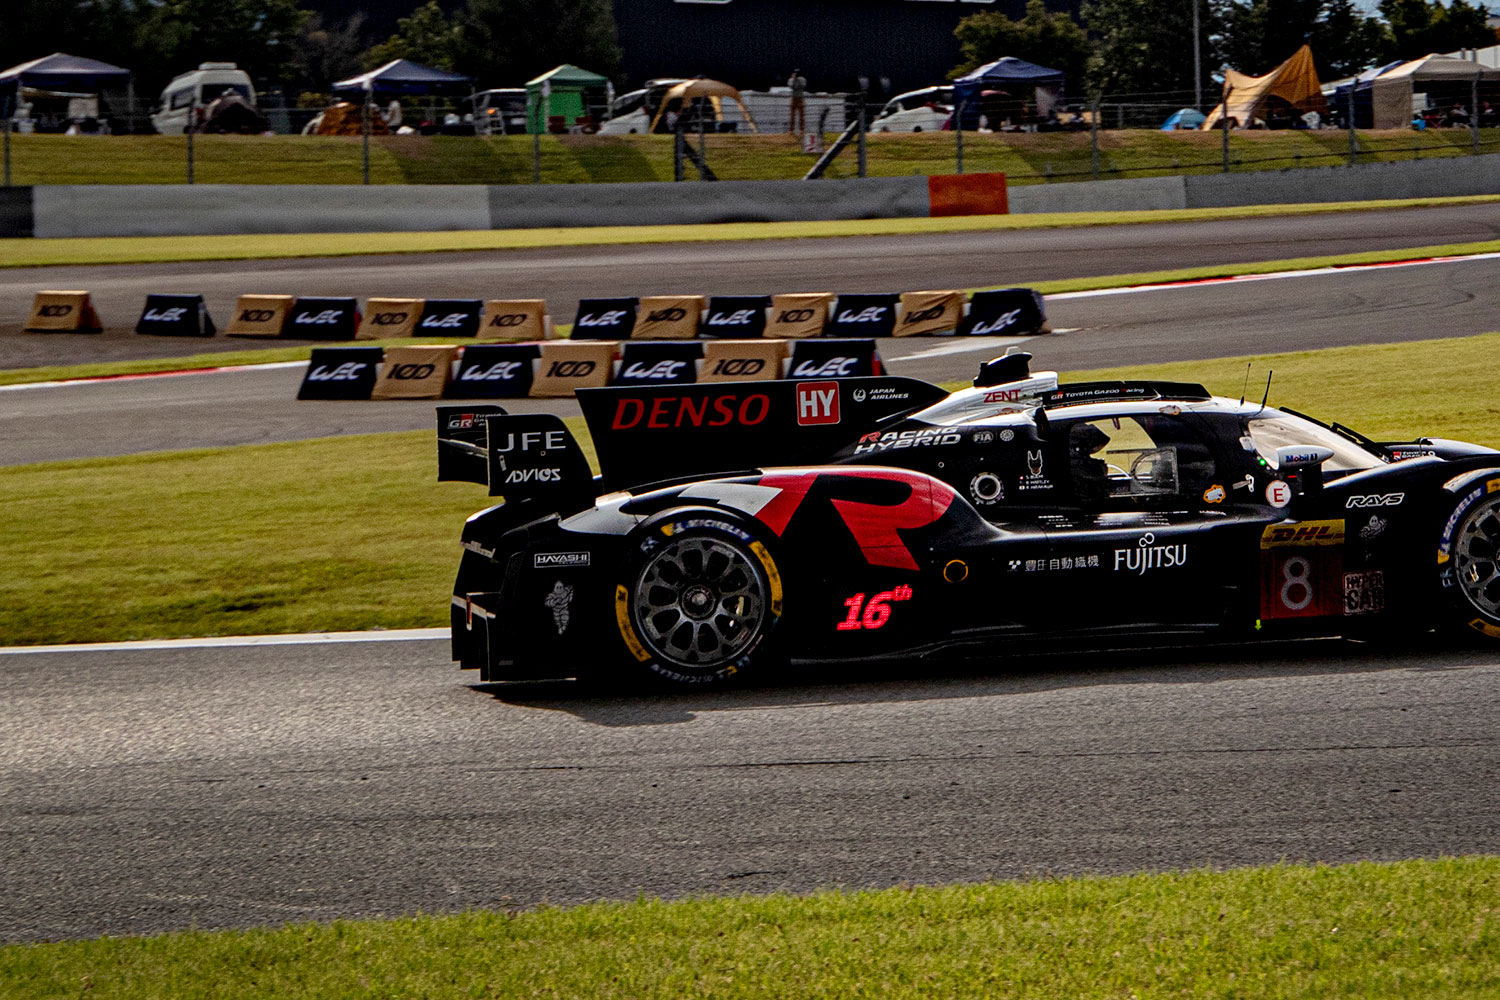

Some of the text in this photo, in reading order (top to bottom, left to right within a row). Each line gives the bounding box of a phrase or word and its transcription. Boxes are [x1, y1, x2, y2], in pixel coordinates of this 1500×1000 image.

[144, 307, 188, 322] WEC
[295, 310, 344, 325] WEC
[422, 313, 469, 328] WEC
[579, 310, 628, 327] WEC
[708, 309, 756, 325] WEC
[837, 306, 888, 323] WEC
[971, 308, 1022, 335] WEC
[308, 362, 367, 381] WEC
[460, 361, 523, 382] WEC
[623, 359, 687, 380] WEC
[793, 357, 859, 377] WEC
[870, 392, 909, 400] AIRLINES
[983, 389, 1022, 403] ZENT
[1065, 391, 1093, 399] TOYOTA
[611, 394, 770, 430] DENSO
[799, 389, 836, 419] HY
[449, 419, 473, 429] GR
[497, 430, 567, 452] JFE
[858, 425, 960, 444] RACING
[974, 433, 992, 442] FIA
[853, 433, 962, 455] HYBRID
[1285, 454, 1309, 463] Mobil
[1346, 492, 1405, 508] RAYS
[1272, 526, 1332, 541] DHL
[537, 554, 588, 563] HAYASHI
[1114, 544, 1187, 576] FUJITSU
[1281, 556, 1313, 610] 8
[1346, 573, 1384, 589] HYPER
